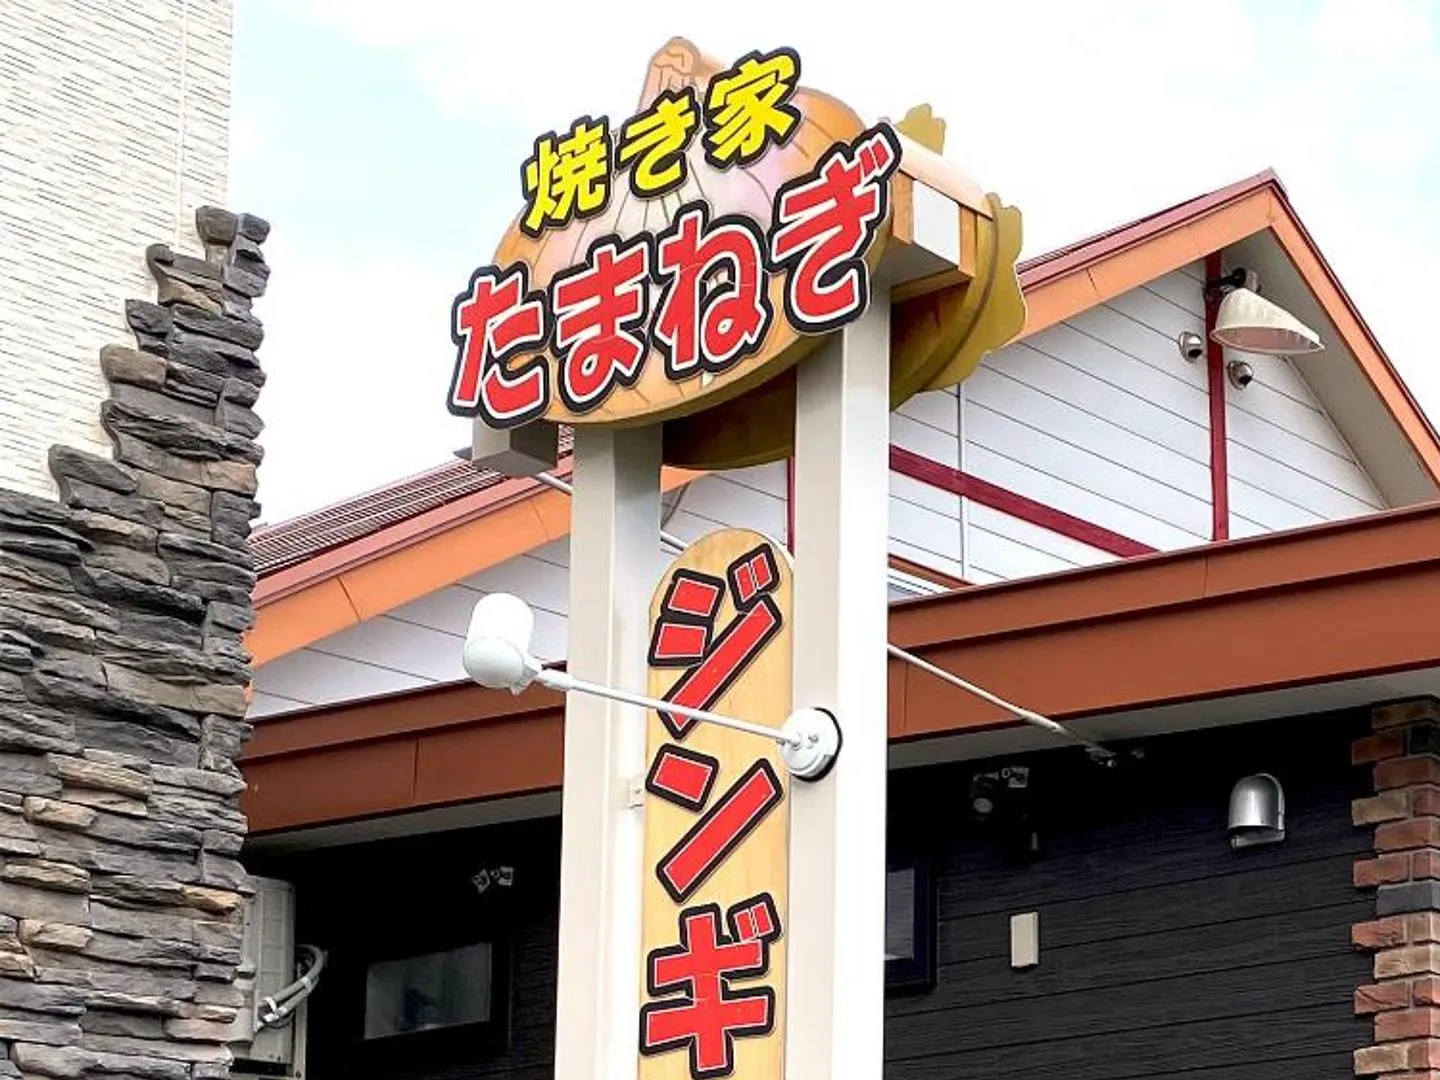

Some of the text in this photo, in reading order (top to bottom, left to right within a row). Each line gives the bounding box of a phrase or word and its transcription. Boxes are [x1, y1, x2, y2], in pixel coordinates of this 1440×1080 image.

[519, 48, 799, 234] 焼き家
[448, 122, 900, 426] たまねぎ
